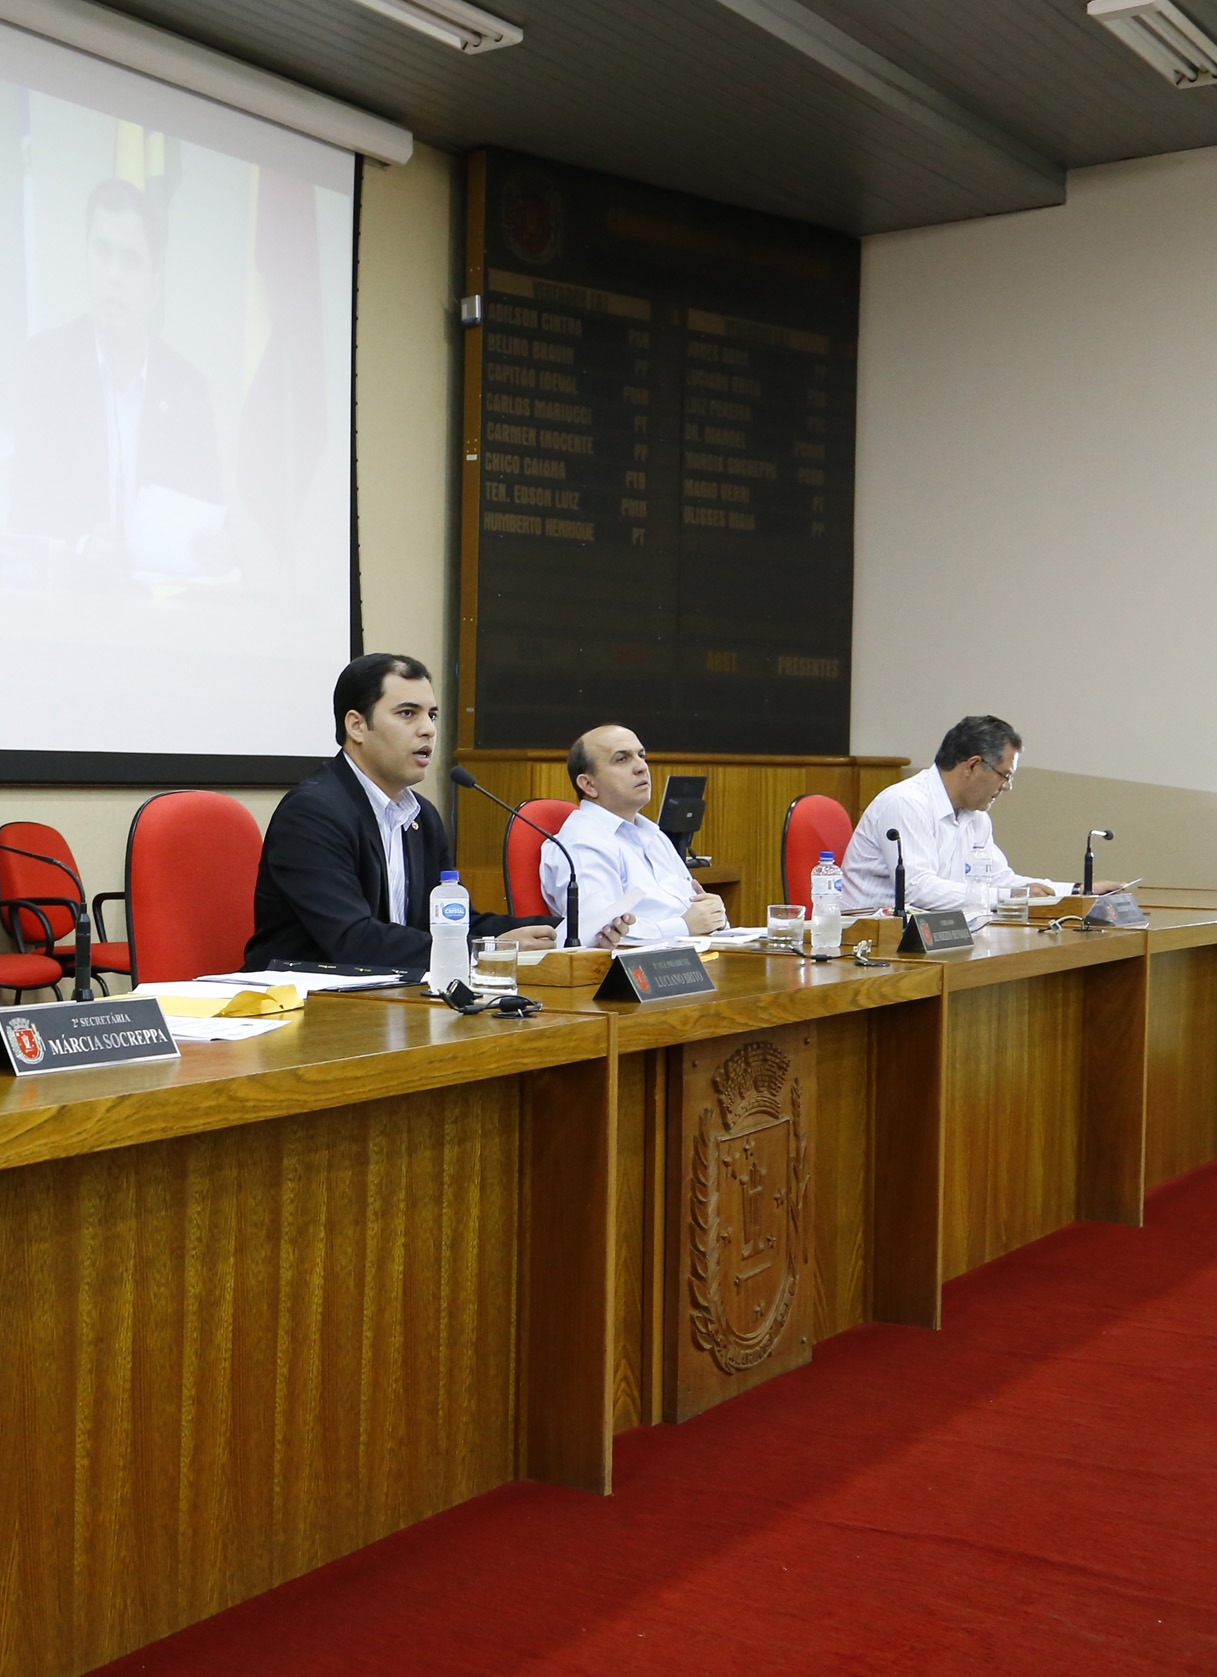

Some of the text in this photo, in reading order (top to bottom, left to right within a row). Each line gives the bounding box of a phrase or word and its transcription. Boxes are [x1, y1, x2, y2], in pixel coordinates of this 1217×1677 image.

[484, 451, 521, 475] CHICO
[513, 484, 552, 508] EDSON
[484, 511, 543, 536] HUMBERTO
[777, 655, 840, 679] PRESENTES
[80, 1012, 131, 1028] SECRETÁRIA
[48, 1028, 169, 1056] MÁRCIA SOCREPPA
